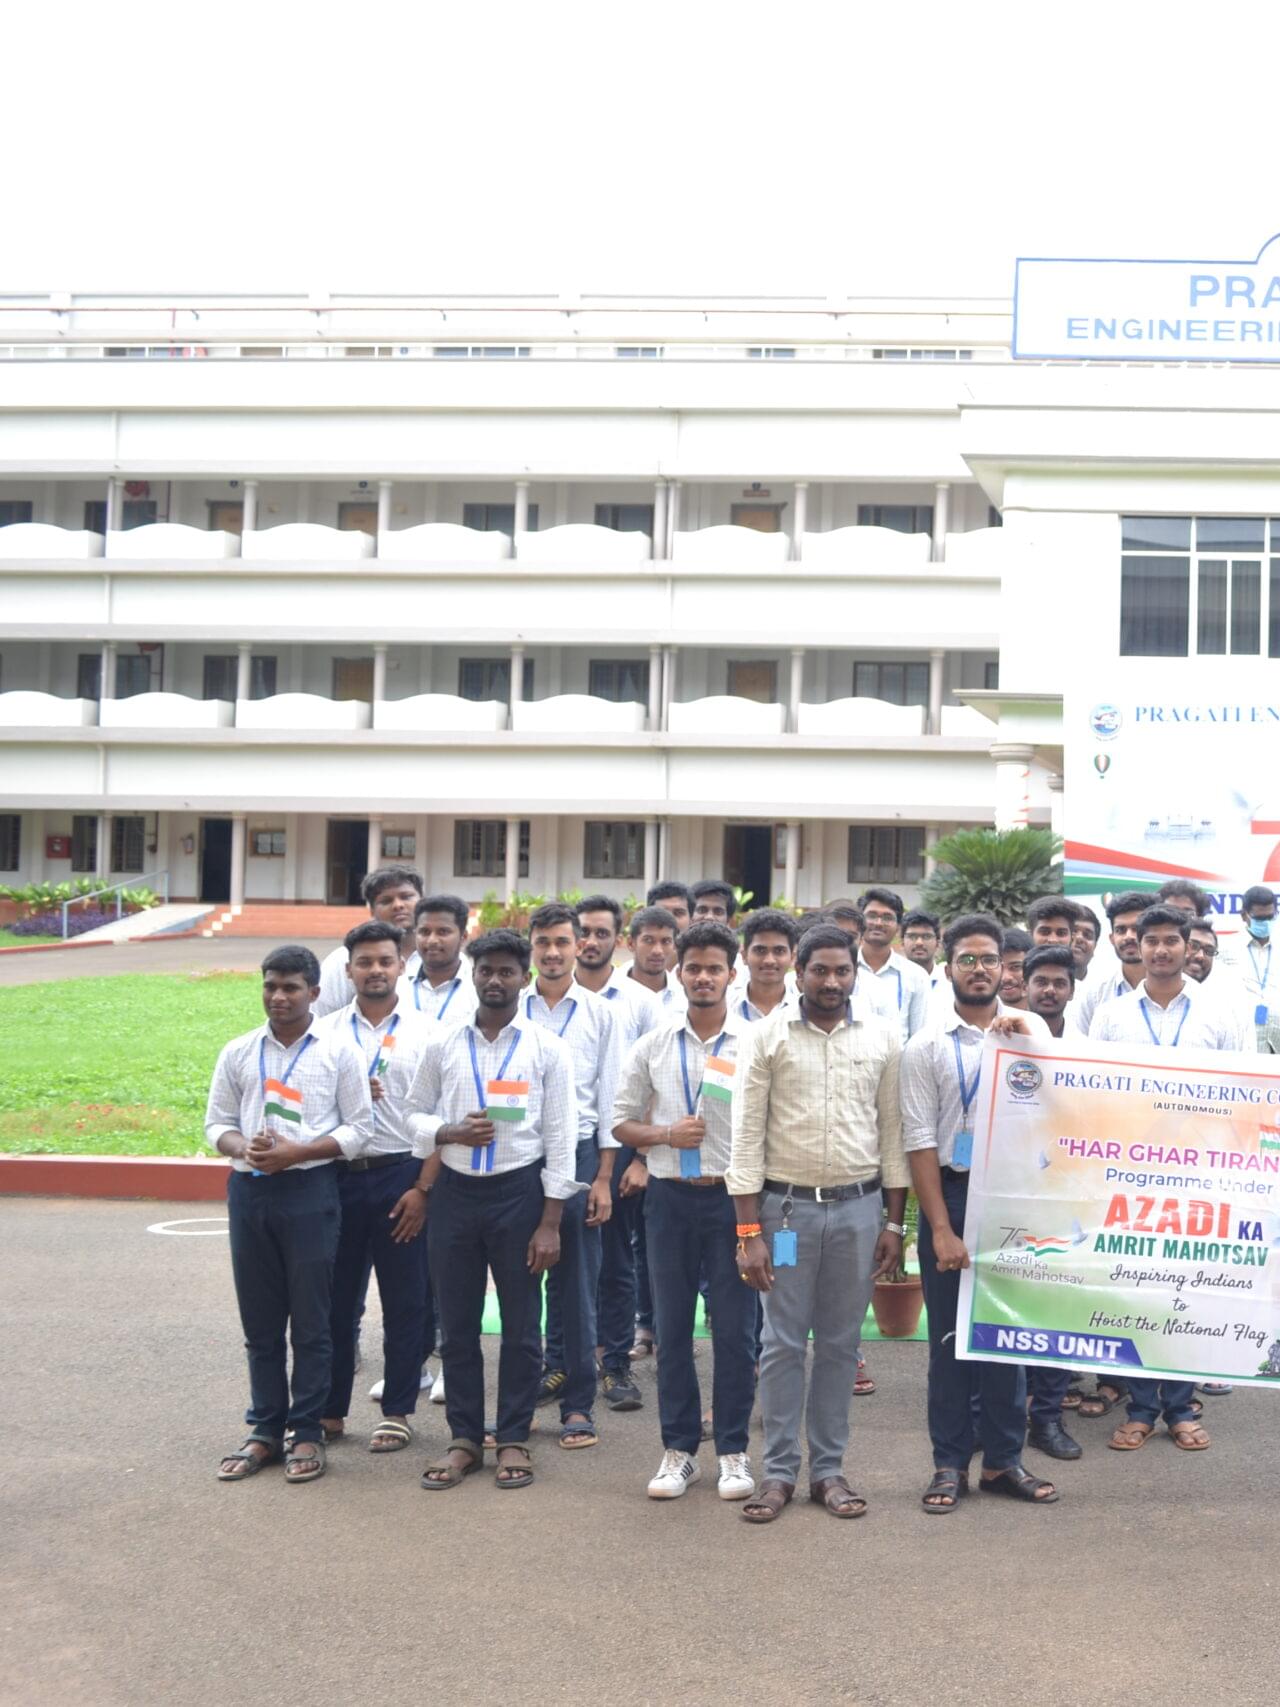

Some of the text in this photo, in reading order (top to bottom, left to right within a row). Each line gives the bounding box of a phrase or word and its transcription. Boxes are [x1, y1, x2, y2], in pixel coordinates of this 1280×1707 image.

[1135, 706, 1241, 722] PRAGATI
[1053, 1071, 1132, 1092] PRAGATI
[1140, 1078, 1261, 1104] ENGINEERING
[1153, 1102, 1233, 1116] (AUTONOMOUS)
[1128, 1143, 1199, 1166] GHAR
[1106, 1168, 1274, 1195] Programme Under
[1103, 1193, 1264, 1242] AZADI KA
[995, 1252, 1033, 1265] Azadi
[1093, 1233, 1269, 1266] AMRIT MAHOTSAV
[991, 1264, 1085, 1285] Amrit Mahotsav
[1109, 1263, 1253, 1291] Inspiring Indians
[1172, 1297, 1190, 1312] to
[1088, 1310, 1269, 1349] Hoist the National Flag
[996, 1329, 1123, 1360] NSS UNIT
